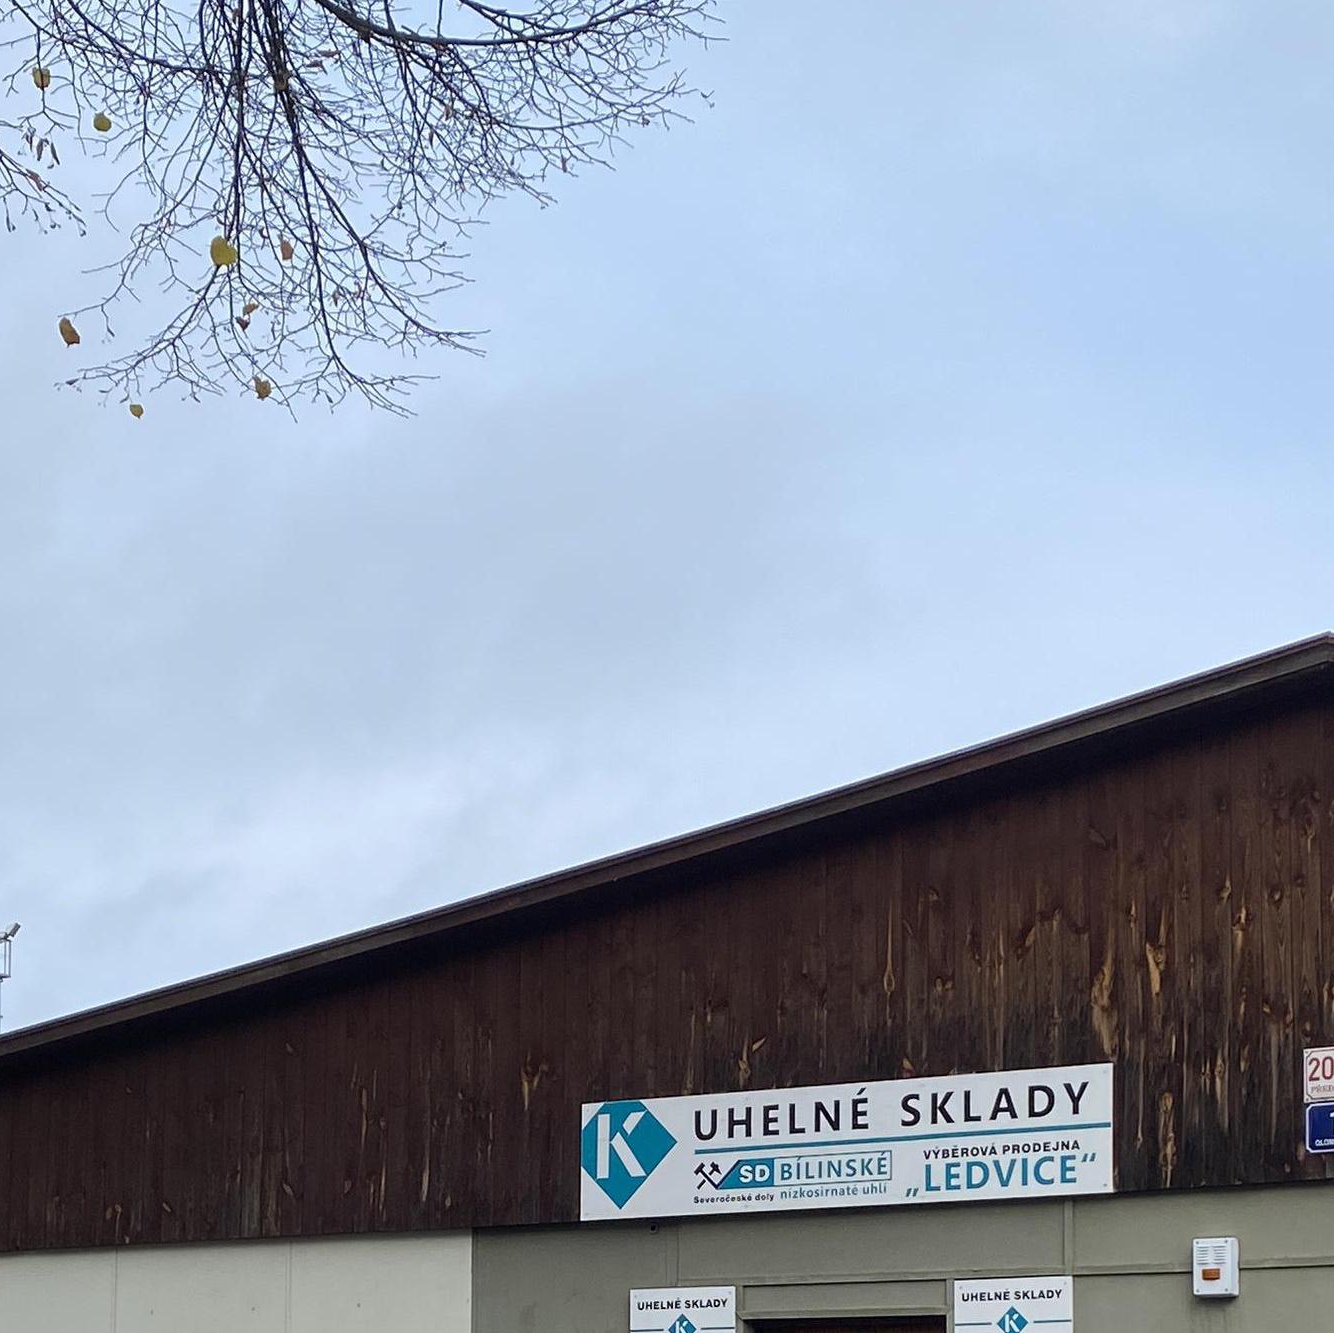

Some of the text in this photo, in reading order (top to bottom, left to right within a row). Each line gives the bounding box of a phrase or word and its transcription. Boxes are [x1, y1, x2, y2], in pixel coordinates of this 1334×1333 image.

[694, 1081, 1090, 1141] UHELNÉ SKLADY
[596, 1110, 648, 1180] K
[923, 1139, 1080, 1160] VÝBĚROVÁ PRODEJNA
[739, 1164, 770, 1183] SD
[780, 1151, 888, 1181] BÍLINSKÉ
[780, 1183, 887, 1200] nízkosirnaté uhlí
[637, 1297, 728, 1311] UHELNÉ SKLADY
[961, 1287, 1062, 1302] UHELNÉ SKLADY
